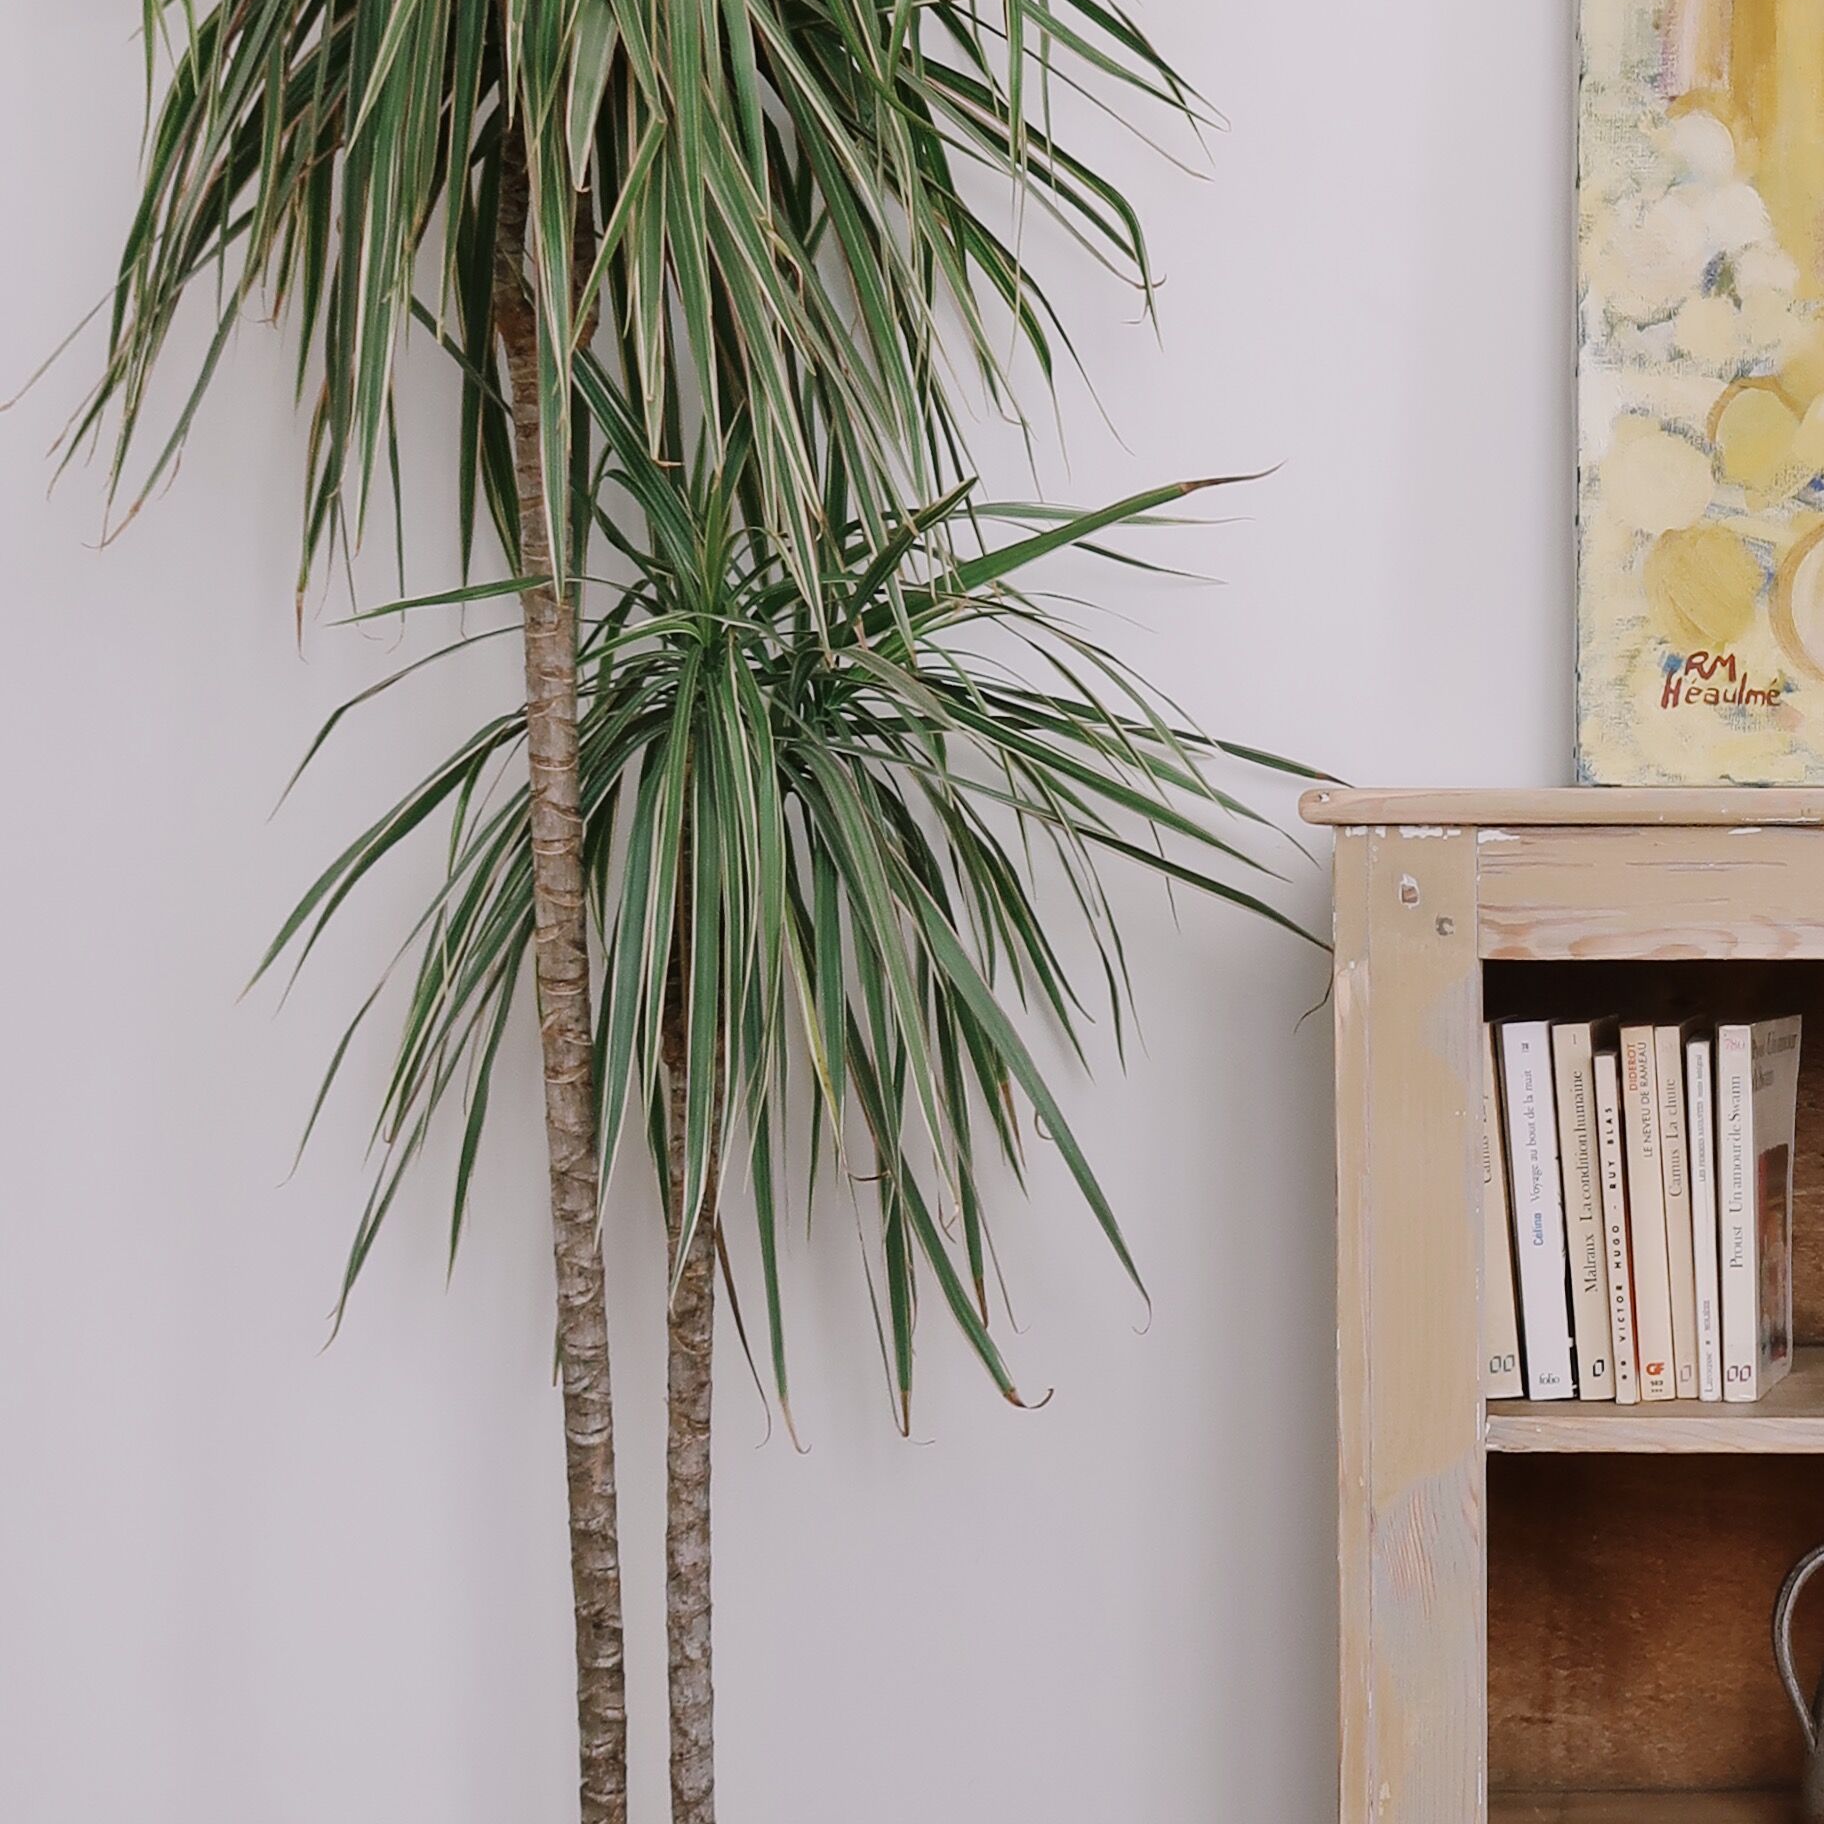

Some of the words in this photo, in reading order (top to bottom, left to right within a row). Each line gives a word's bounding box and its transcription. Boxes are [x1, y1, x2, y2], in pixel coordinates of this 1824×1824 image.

[1684, 650, 1738, 682] RM
[1523, 1069, 1534, 1092] nuit
[1625, 1043, 1642, 1092] DIDEROT
[1636, 1041, 1649, 1088] RAMEAU
[1522, 1093, 1534, 1105] la
[1522, 1106, 1536, 1120] de
[1570, 1070, 1587, 1132] humaine
[1639, 1091, 1651, 1105] DE
[1664, 1078, 1678, 1116] chute
[1727, 1075, 1741, 1122] Swann
[1525, 1121, 1537, 1147] bout
[1604, 1107, 1615, 1145] BLAS
[1640, 1107, 1652, 1144] NEVEU
[1665, 1121, 1680, 1140] La
[1726, 1124, 1742, 1142] de
[1530, 1148, 1539, 1162] au
[1574, 1133, 1592, 1201] condition
[1642, 1146, 1654, 1158] LE
[1732, 1144, 1743, 1189] amour
[1529, 1164, 1544, 1203] Voyage
[1607, 1160, 1617, 1190] RUY
[1668, 1148, 1683, 1198] Camus
[1579, 1202, 1594, 1222] La
[1728, 1191, 1743, 1214] Un
[1583, 1233, 1598, 1293] Malraux
[1611, 1224, 1622, 1270] HUGO
[1729, 1226, 1744, 1269] Proust
[1615, 1284, 1627, 1343] VICTOR
